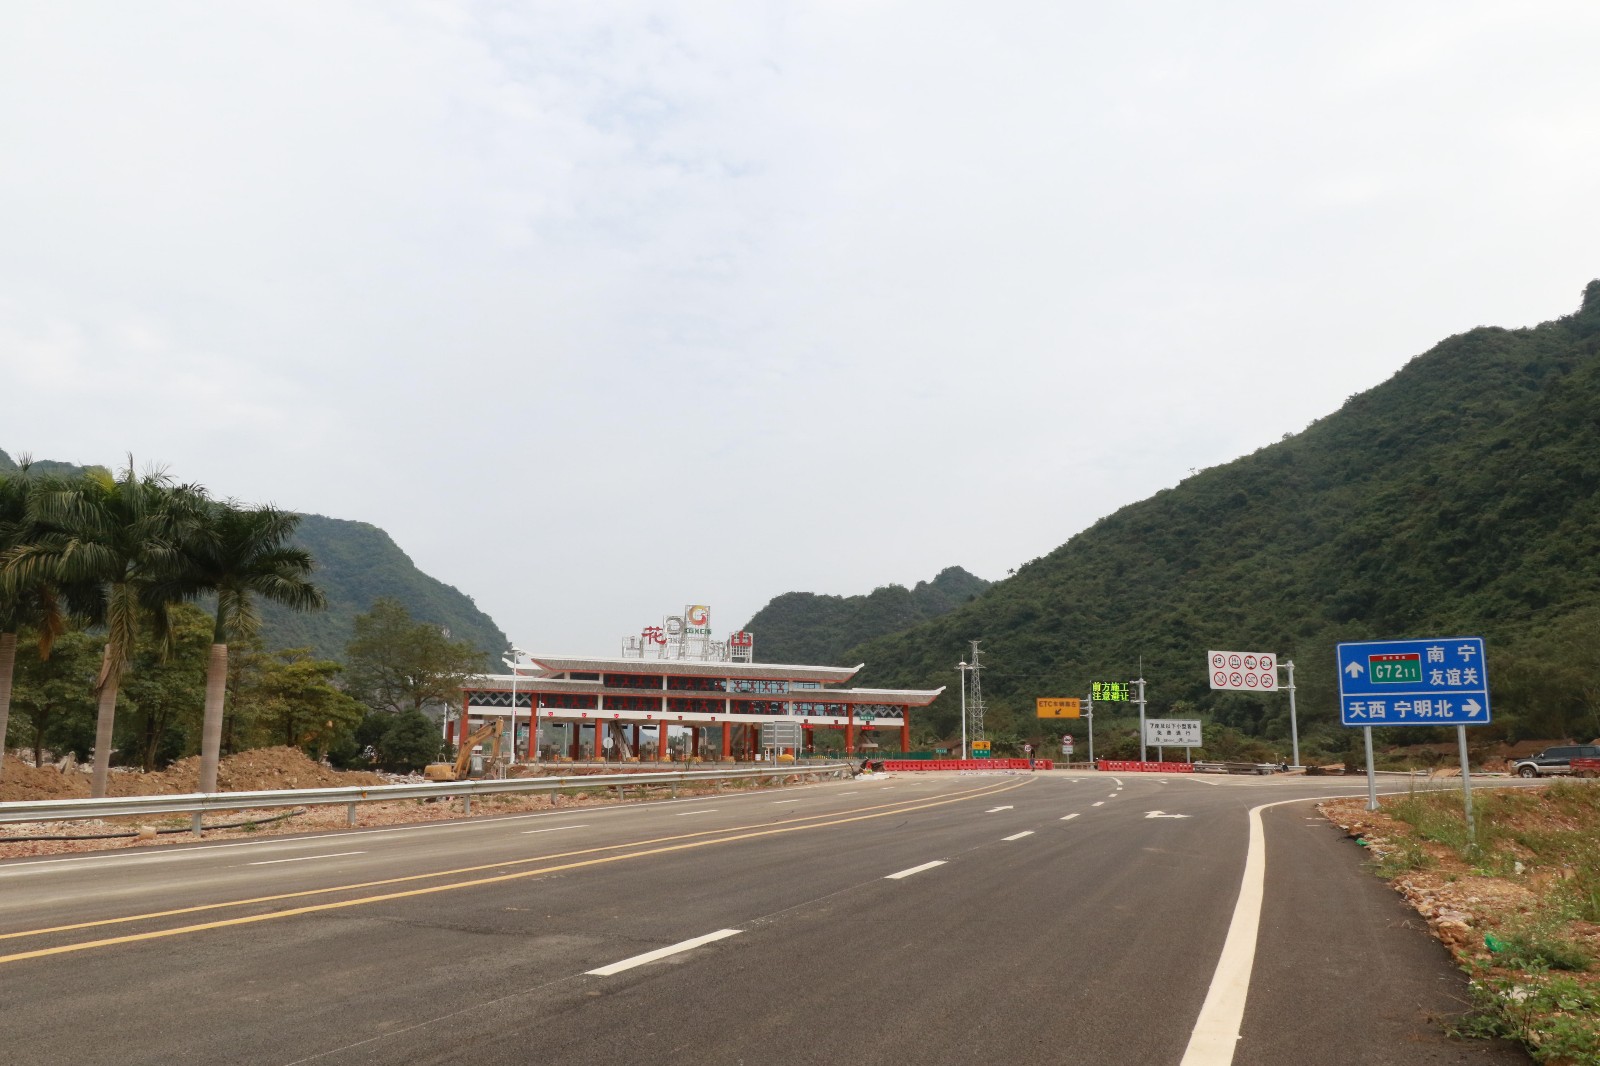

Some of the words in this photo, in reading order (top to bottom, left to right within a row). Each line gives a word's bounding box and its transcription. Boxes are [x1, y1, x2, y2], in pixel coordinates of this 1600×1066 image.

[641, 626, 667, 645] 花
[731, 630, 752, 647] 山
[1426, 644, 1477, 663] 南宁
[1375, 664, 1416, 679] G7211
[1429, 668, 1479, 686] 友谊关
[1092, 682, 1129, 691] 前方施工
[1349, 701, 1387, 719] 天西
[1394, 699, 1454, 718] 宁明北
